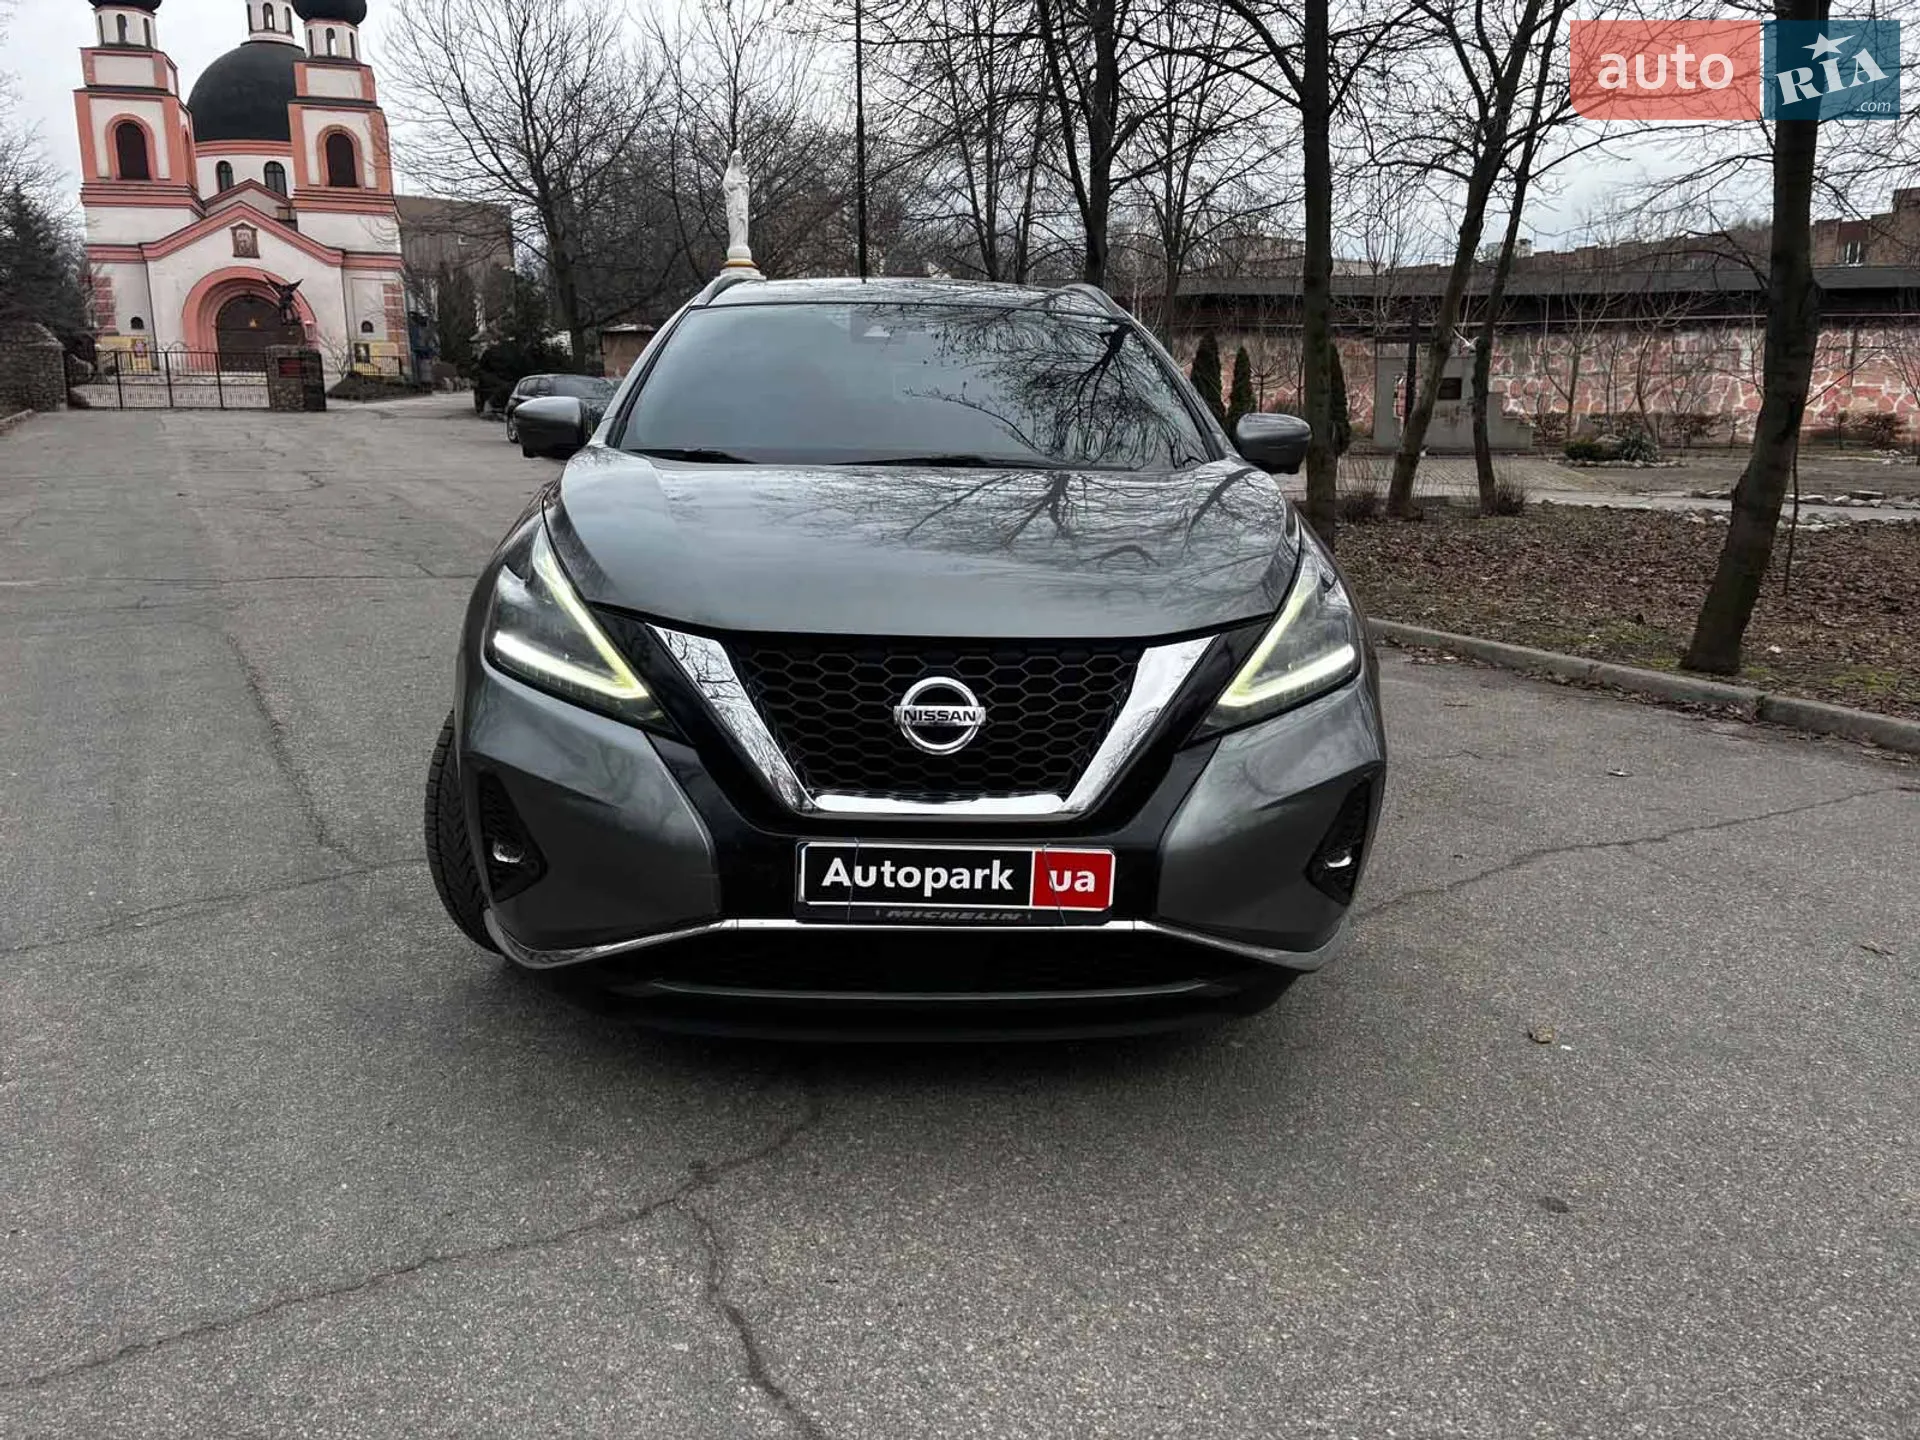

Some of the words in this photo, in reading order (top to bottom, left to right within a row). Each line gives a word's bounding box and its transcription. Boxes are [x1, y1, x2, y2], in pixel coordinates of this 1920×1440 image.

[903, 709, 976, 722] NISSAN
[821, 857, 1014, 897] Autopark
[1049, 868, 1095, 892] ua
[885, 909, 1023, 921] MICHELIN
